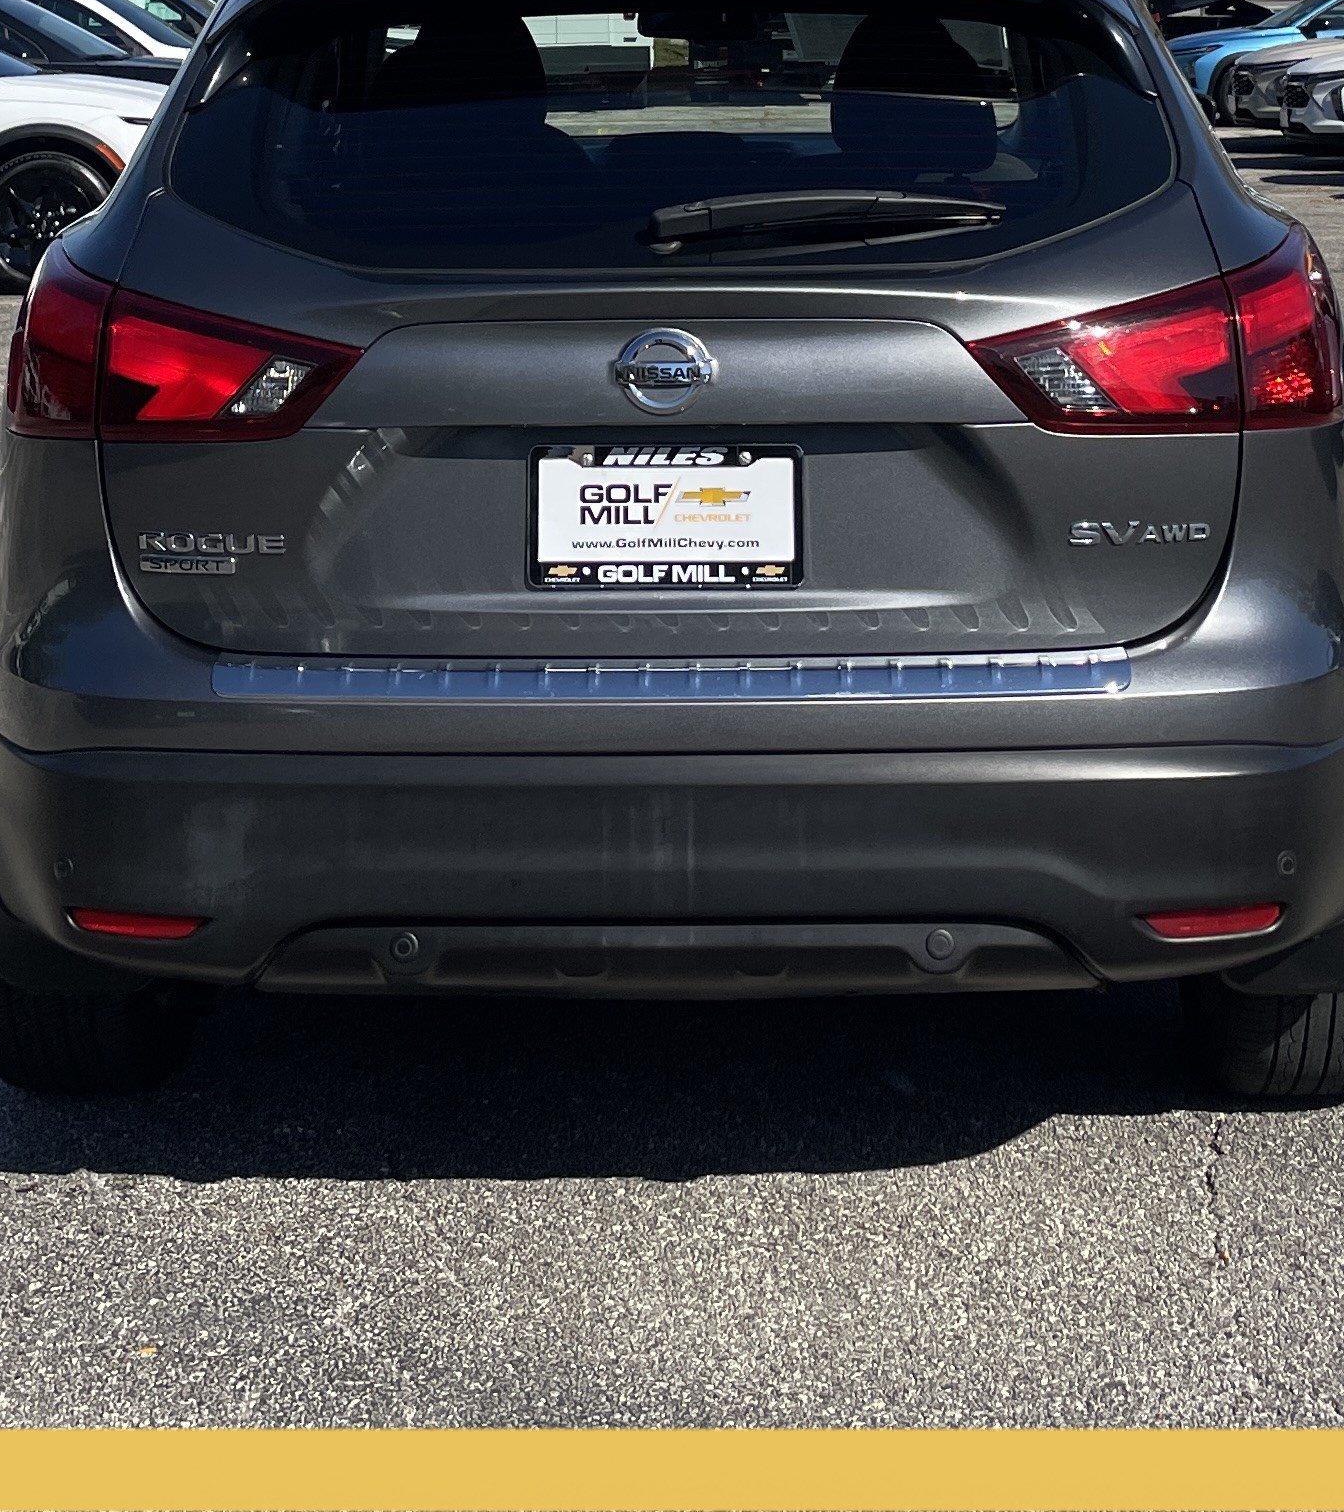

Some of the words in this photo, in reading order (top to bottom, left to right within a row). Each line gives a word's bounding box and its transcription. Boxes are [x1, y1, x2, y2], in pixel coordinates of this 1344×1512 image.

[625, 366, 700, 381] NISSAN
[603, 447, 729, 466] NILES
[579, 483, 674, 504] GOLF
[579, 505, 656, 525] MILL
[674, 513, 752, 523] CHEVROLET
[137, 530, 287, 555] ROGUE
[1139, 523, 1211, 544] AWD
[571, 538, 761, 550] www.GolfMillChevy.com
[148, 558, 226, 572] SPORT
[597, 564, 670, 584] GOLF
[671, 564, 736, 584] MILL
